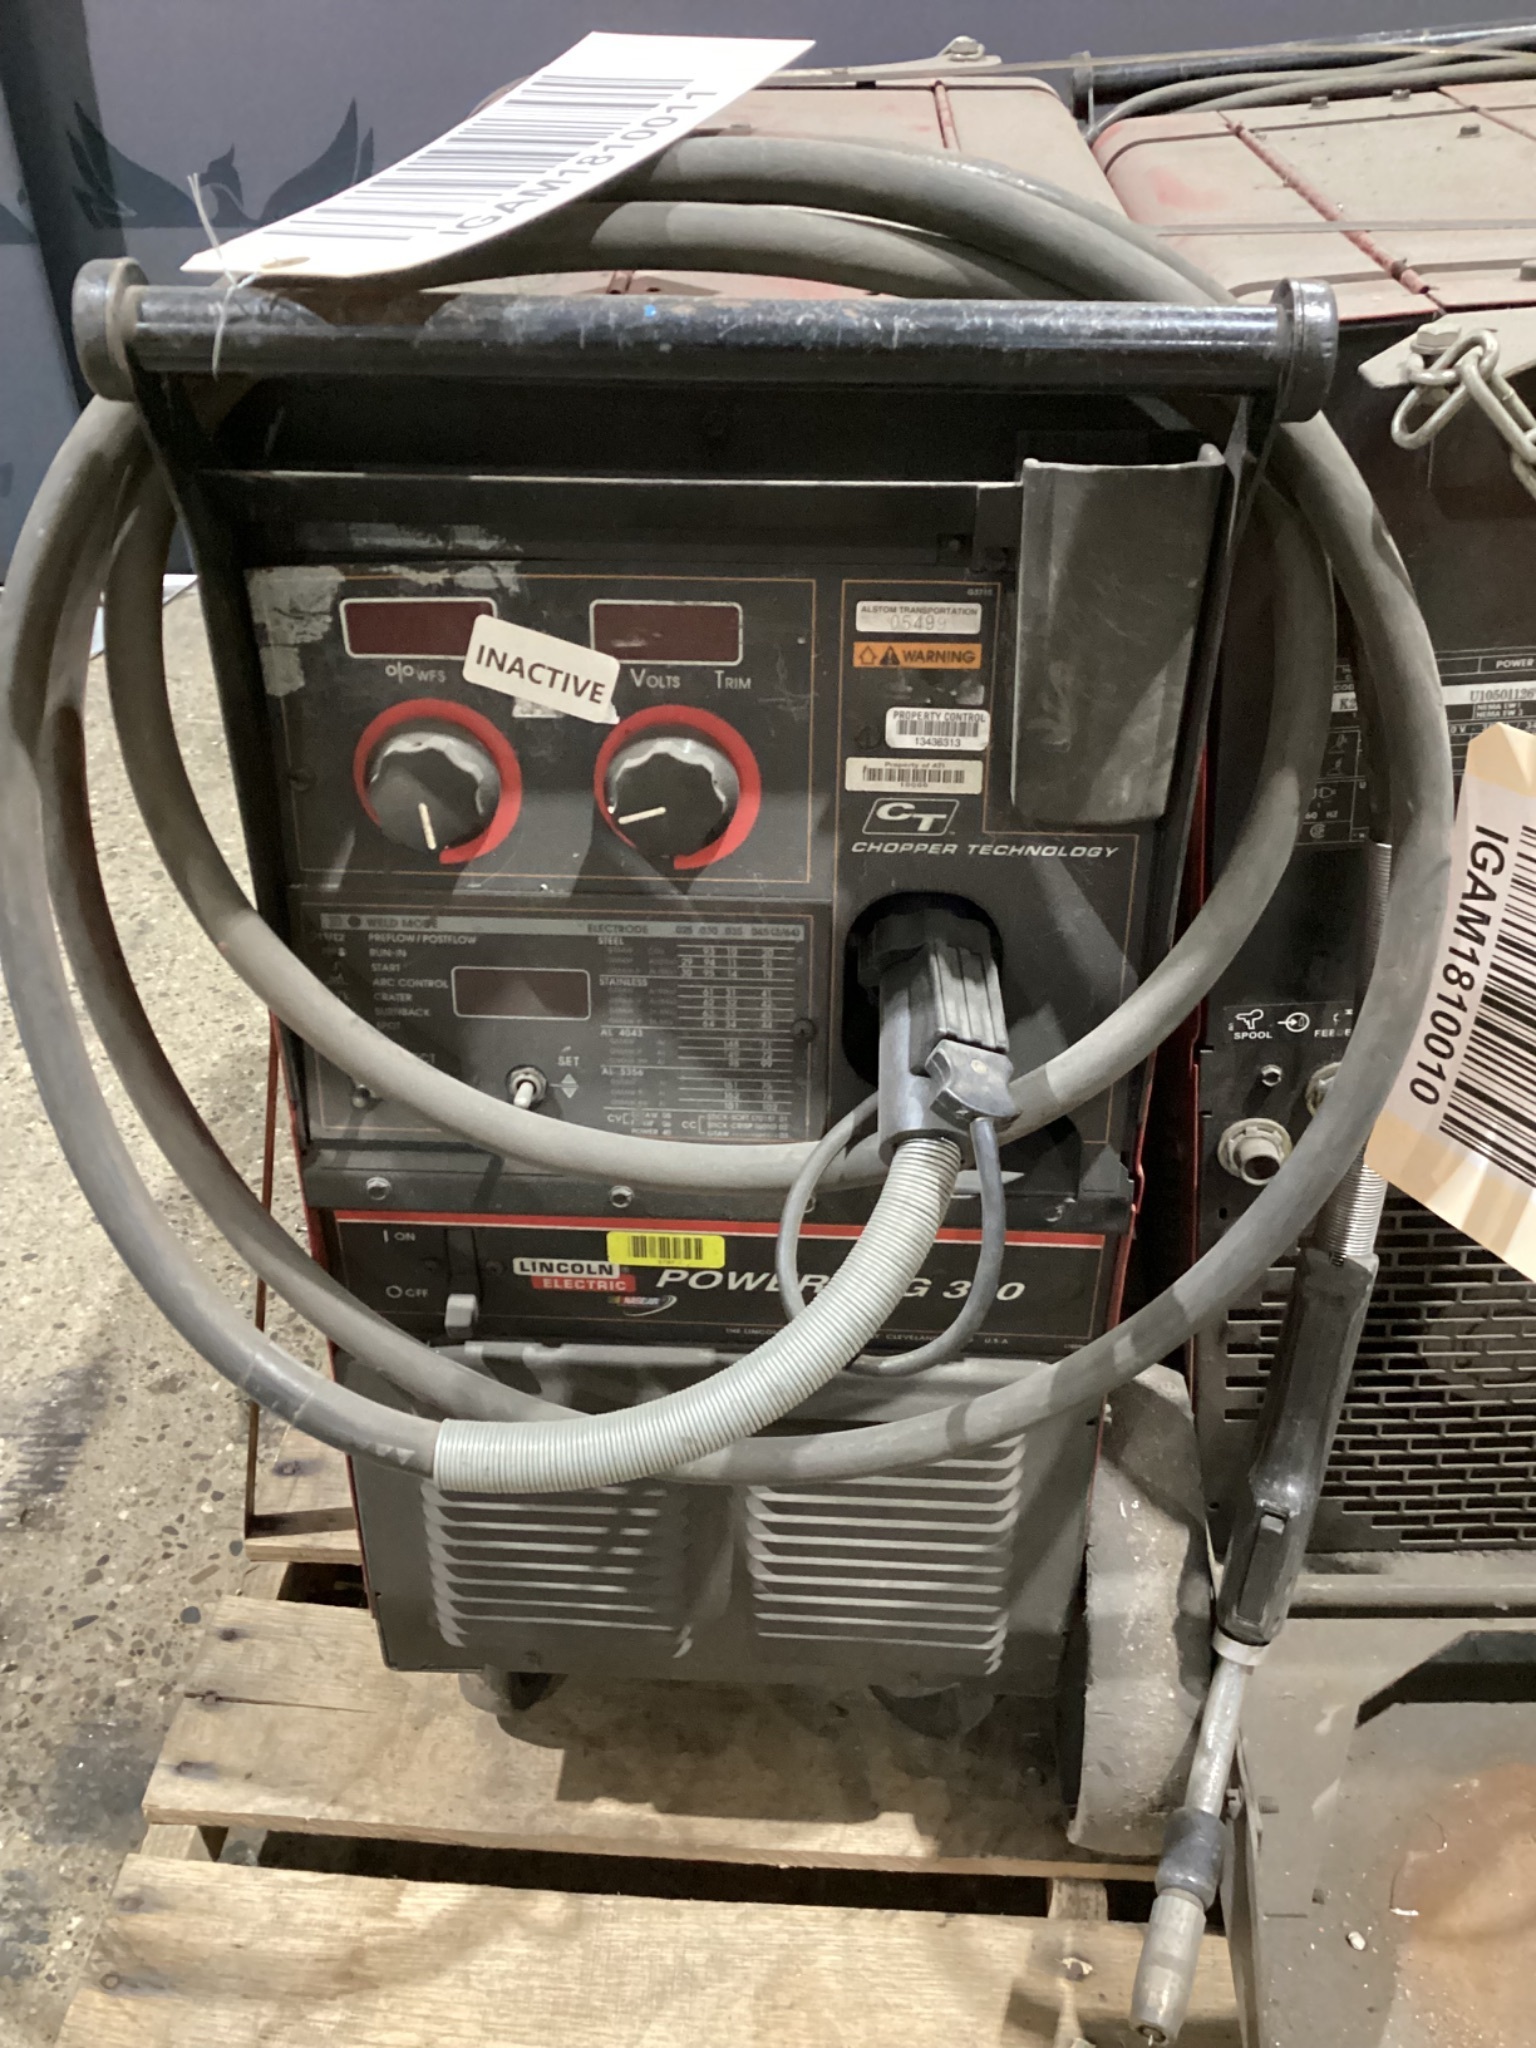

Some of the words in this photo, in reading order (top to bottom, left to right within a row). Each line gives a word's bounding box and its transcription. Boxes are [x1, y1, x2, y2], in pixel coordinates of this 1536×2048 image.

[439, 92, 717, 236] IGAM1810011
[861, 605, 897, 614] ALSTOM
[900, 606, 978, 616] TRANSPORTATION
[902, 649, 976, 665] WARNING
[415, 670, 447, 683] WFS
[475, 643, 606, 705] INACTIVE
[893, 711, 941, 721] PROPERTY
[944, 712, 986, 723] CONTROL
[876, 802, 948, 832] CT
[851, 841, 958, 855] CHOPPER
[968, 844, 1119, 858] TECHNOLOGY
[587, 923, 649, 934] ELECTRODE
[371, 962, 401, 972] START
[1409, 824, 1509, 1106] IGAM1810010
[397, 978, 449, 989] CONTROL
[1233, 1031, 1273, 1040] SPOOL
[1313, 1028, 1352, 1038] FEEE
[557, 1055, 580, 1067] SET
[681, 1120, 697, 1129] CC
[394, 1232, 416, 1242] ON
[518, 1260, 613, 1276] LINCOLN
[542, 1278, 627, 1291] ELECTRIC
[942, 1279, 1027, 1301] 30
[405, 1287, 429, 1298] OFF
